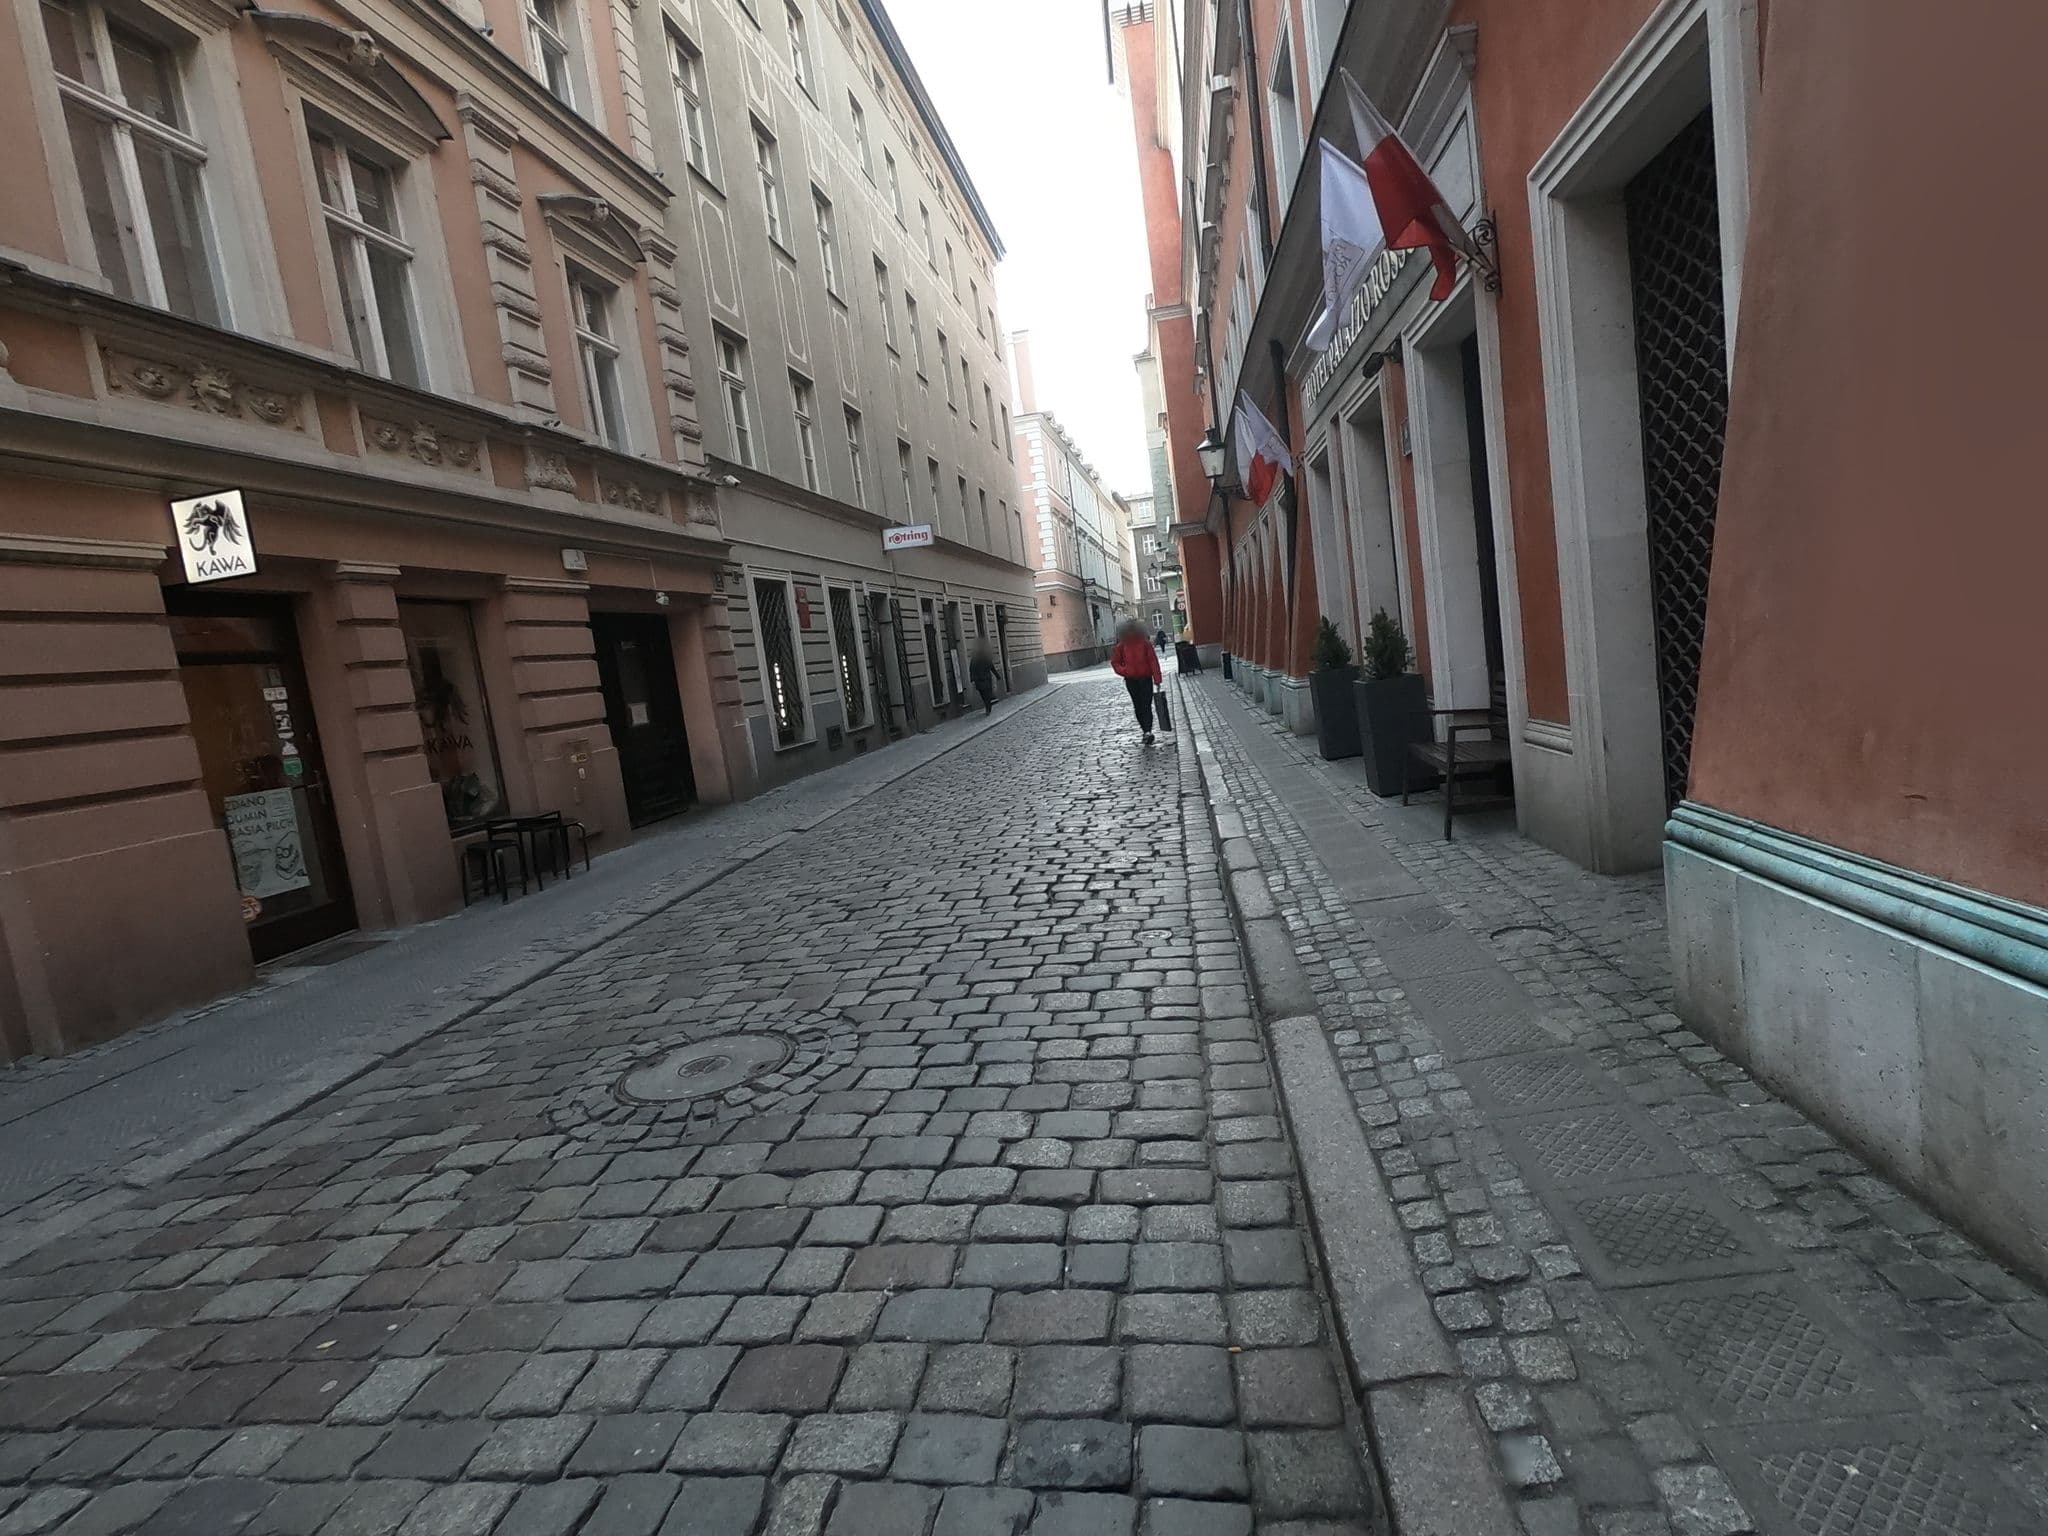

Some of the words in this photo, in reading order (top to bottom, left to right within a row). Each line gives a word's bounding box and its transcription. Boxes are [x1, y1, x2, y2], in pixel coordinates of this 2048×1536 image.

[1305, 354, 1330, 408] HOTEL
[888, 530, 929, 544] rotring
[196, 556, 247, 577] KAWA
